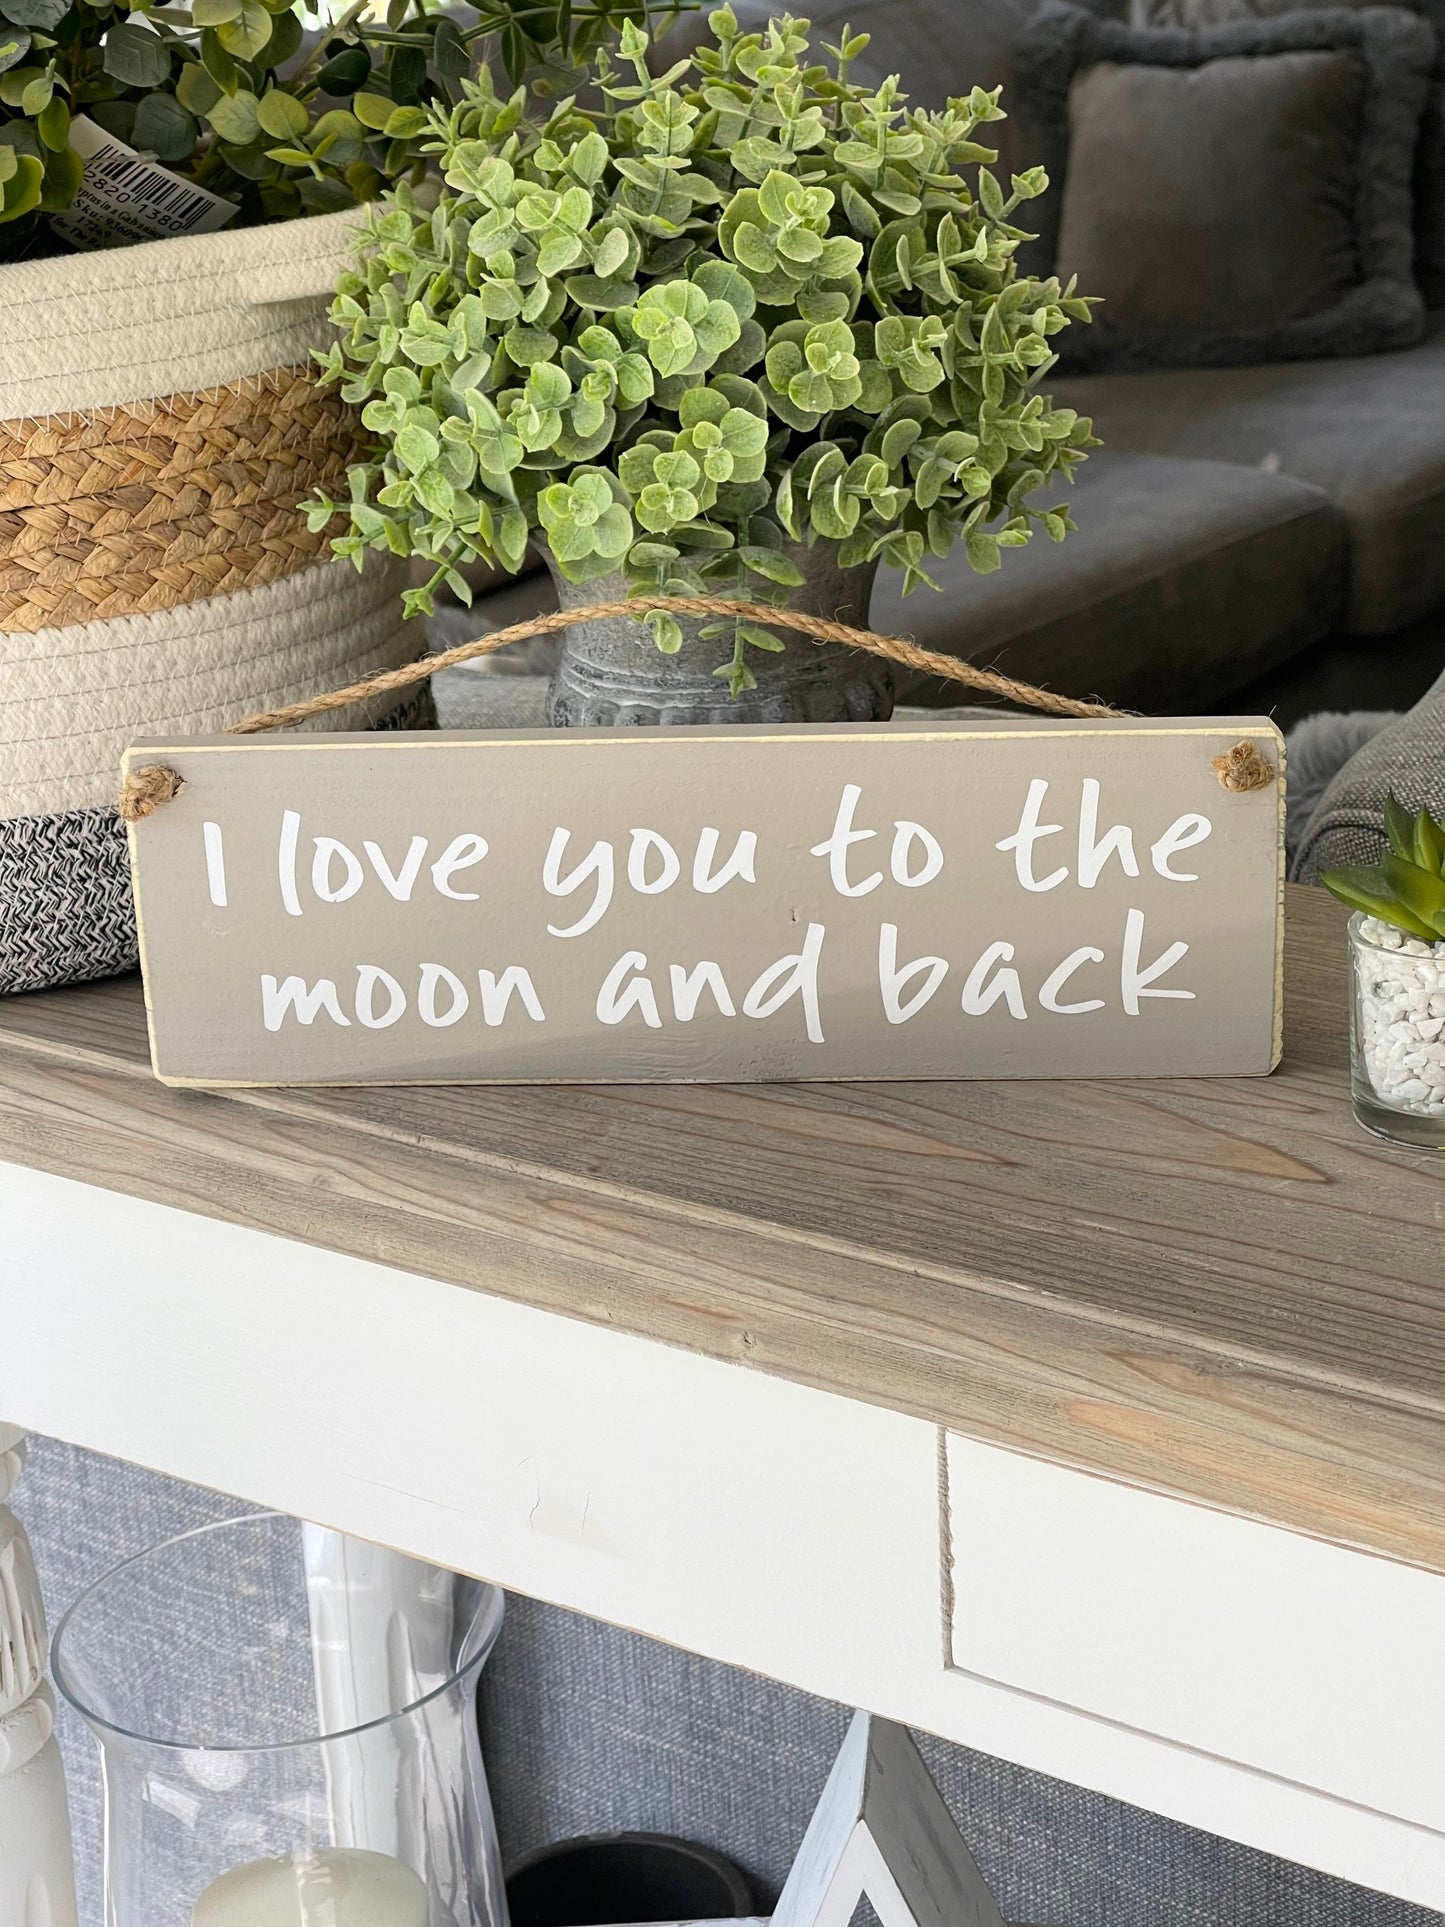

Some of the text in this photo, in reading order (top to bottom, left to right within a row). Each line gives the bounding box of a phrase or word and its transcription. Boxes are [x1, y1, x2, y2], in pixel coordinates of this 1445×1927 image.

[74, 200, 103, 221] Sku:
[100, 201, 112, 210] in
[137, 204, 183, 232] 1380
[201, 777, 1213, 939] I love you to the
[259, 907, 1197, 1045] moon and back
